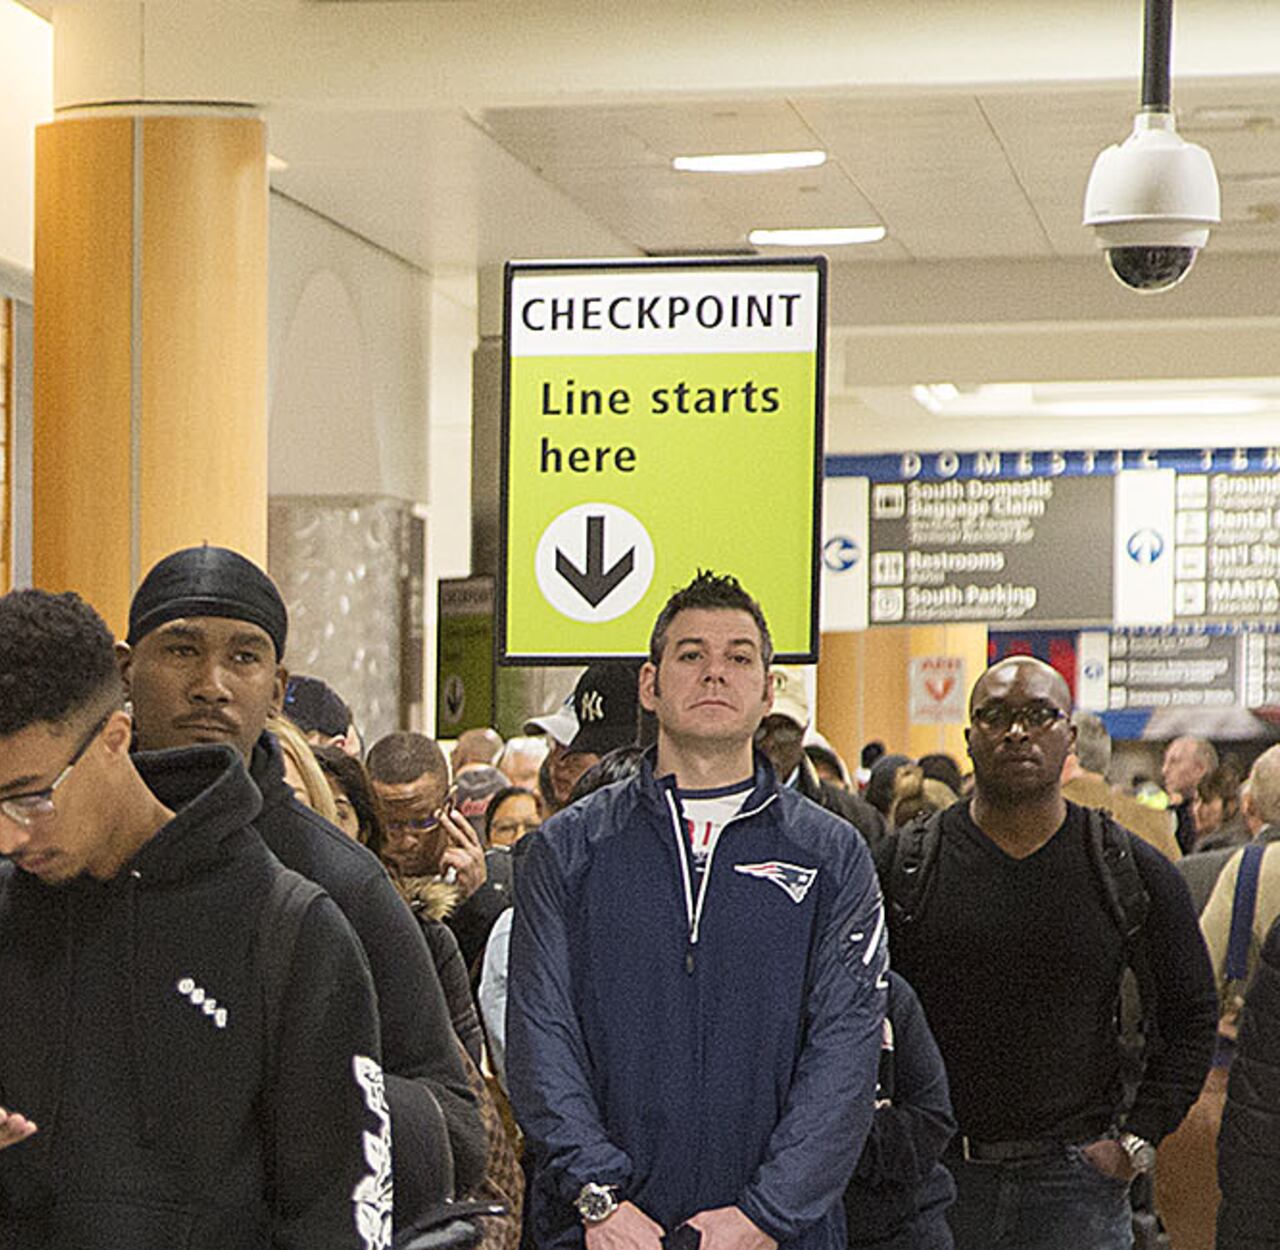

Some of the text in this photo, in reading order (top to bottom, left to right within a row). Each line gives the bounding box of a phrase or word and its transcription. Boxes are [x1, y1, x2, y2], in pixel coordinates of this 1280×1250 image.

[521, 293, 802, 331] CHECKPOINT
[541, 378, 781, 416] Line starts
[539, 437, 636, 473] here
[966, 477, 1053, 500] Domestic
[907, 551, 1004, 572] Restrooms
[907, 582, 1037, 609] South Parking
